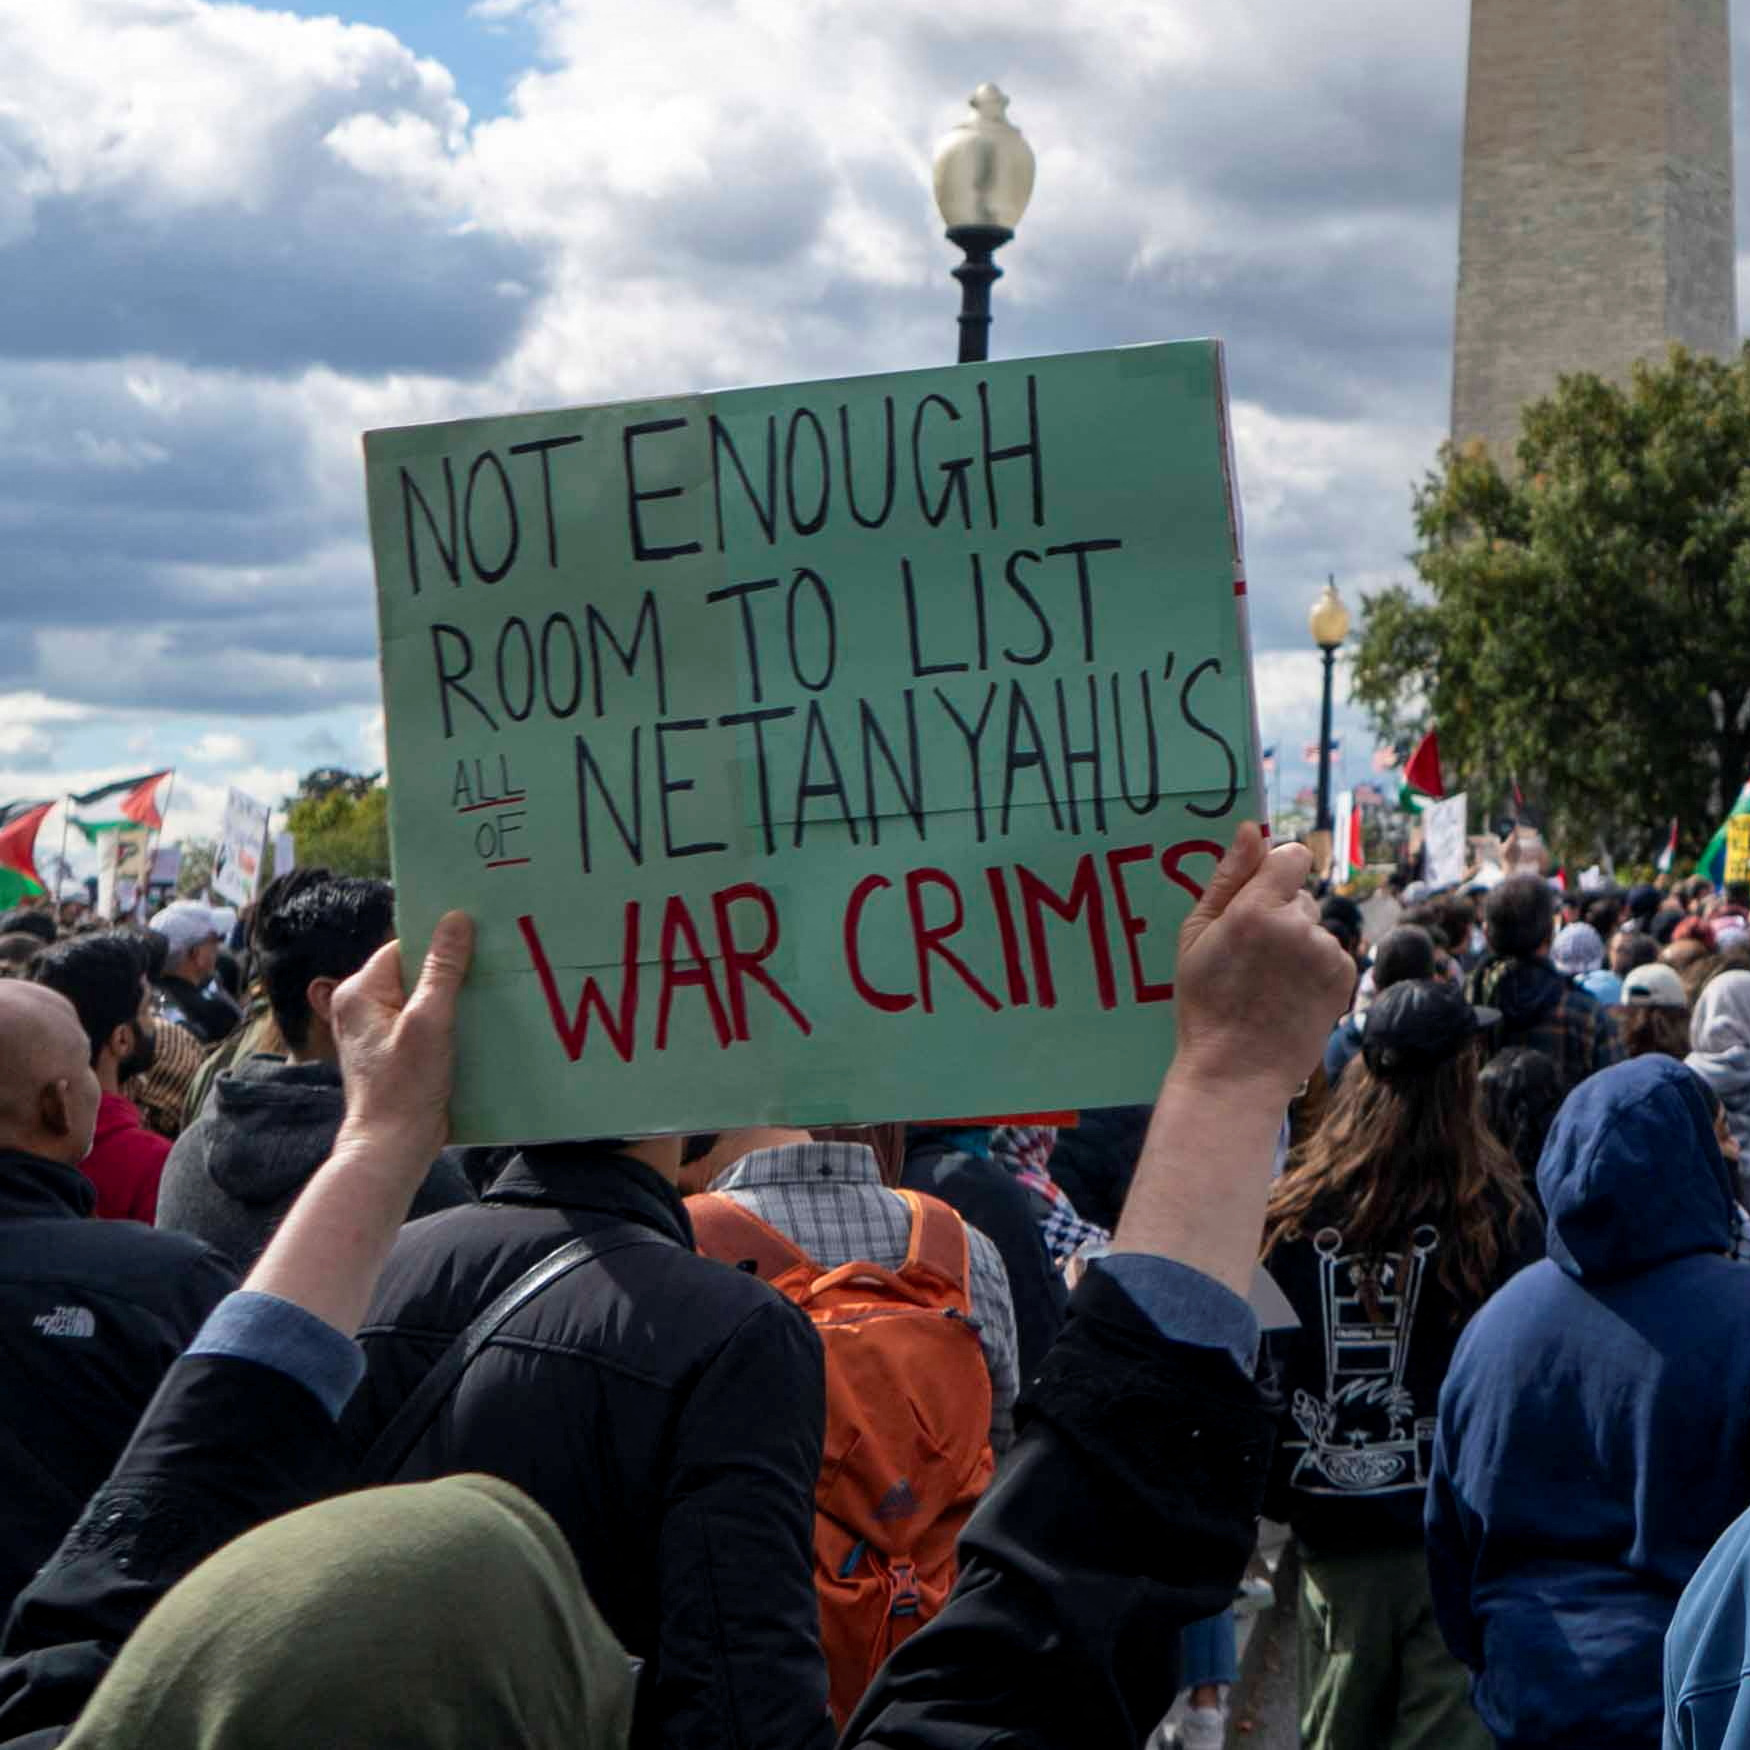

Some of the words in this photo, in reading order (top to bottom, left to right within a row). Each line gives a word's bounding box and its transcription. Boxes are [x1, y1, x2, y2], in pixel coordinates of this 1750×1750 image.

[396, 434, 584, 597] NOT
[621, 373, 1047, 563] ENOUGH
[427, 587, 668, 740] ROOM
[704, 566, 838, 704] TO
[900, 537, 1124, 678] LIST
[451, 753, 527, 807] ALL
[474, 810, 528, 859] OF
[574, 651, 1241, 874] NETANYAHU'S
[516, 882, 813, 1065] WAR
